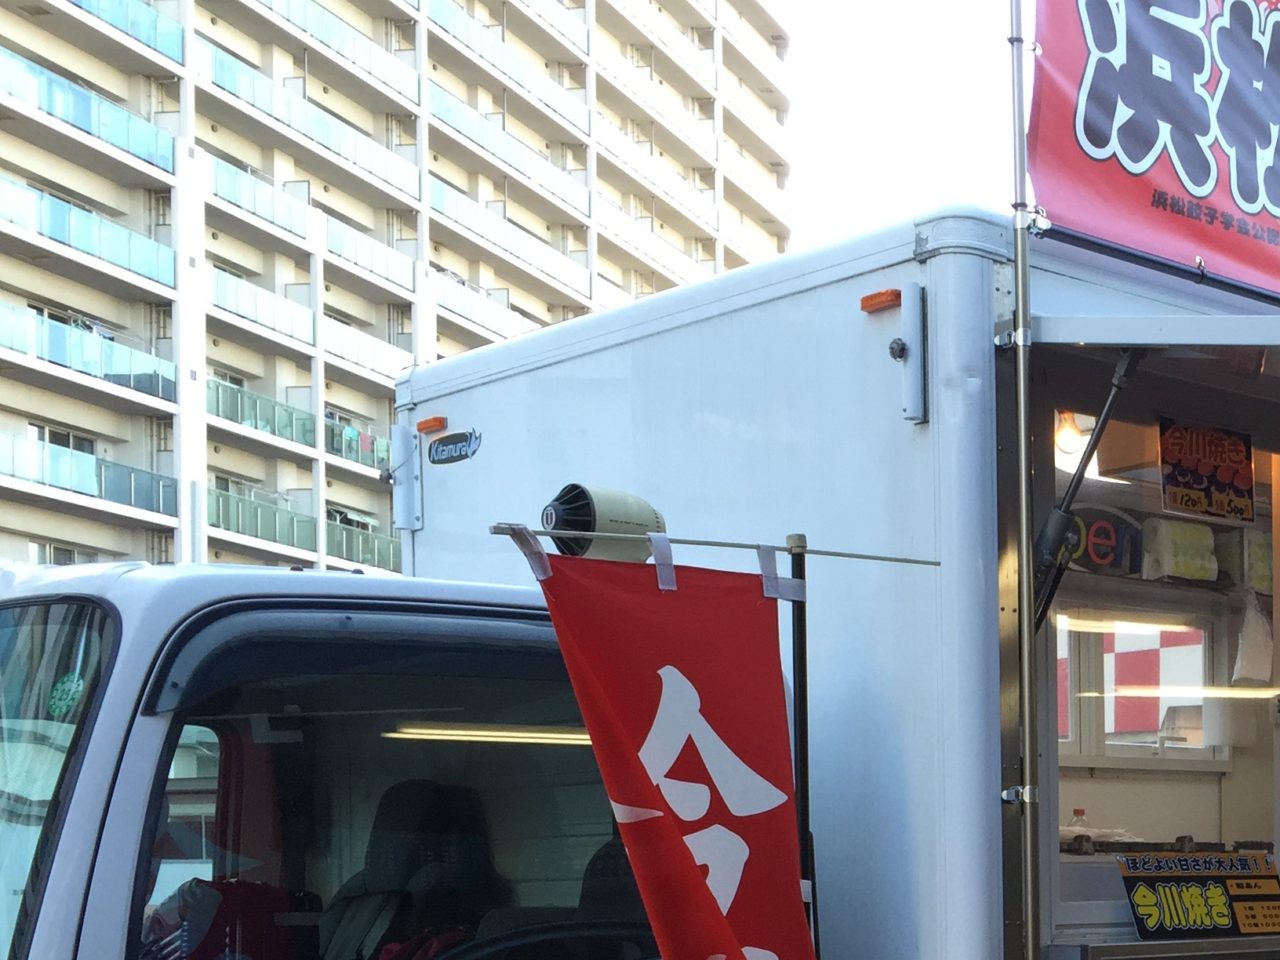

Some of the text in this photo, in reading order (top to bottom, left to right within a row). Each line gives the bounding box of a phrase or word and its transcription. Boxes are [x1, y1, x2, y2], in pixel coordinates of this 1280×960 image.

[430, 440, 467, 462] Kitamura
[1166, 424, 1247, 466] 今川焼き
[1131, 881, 1233, 931] 今川焼き
